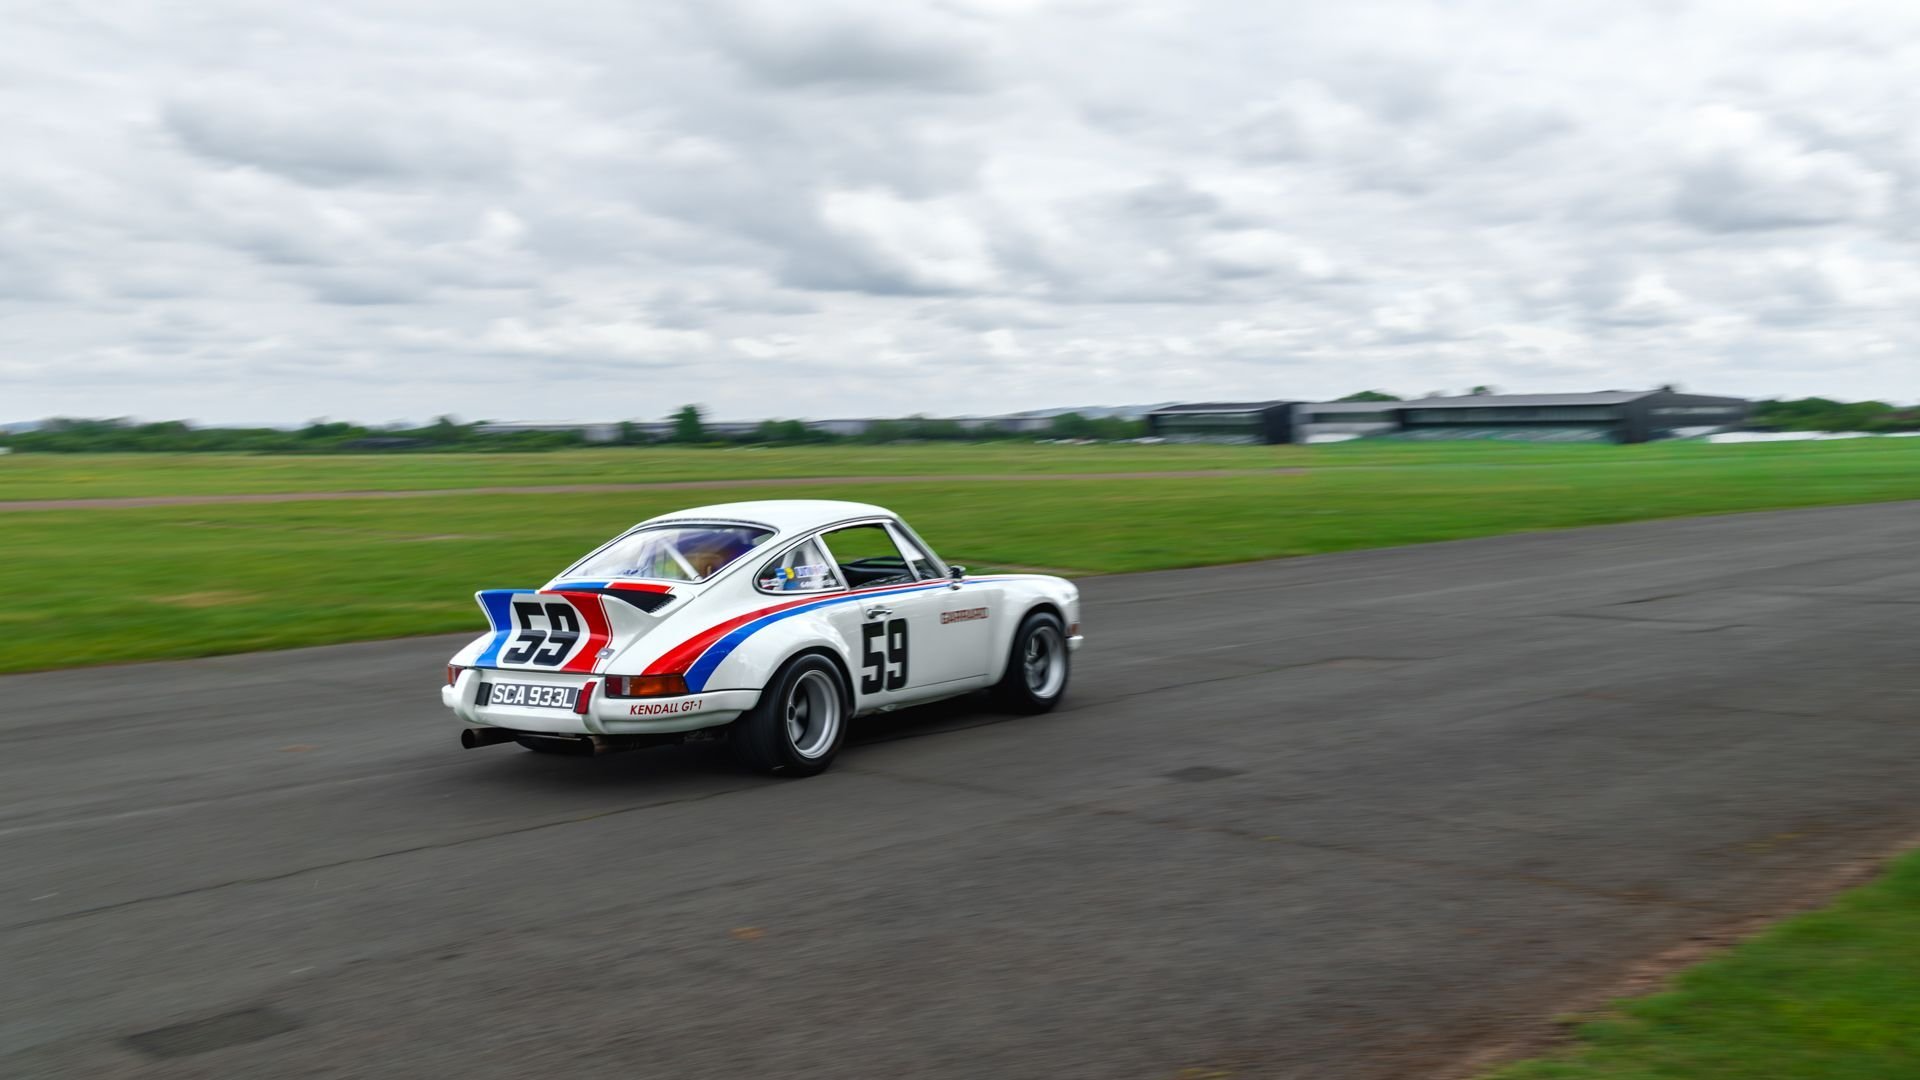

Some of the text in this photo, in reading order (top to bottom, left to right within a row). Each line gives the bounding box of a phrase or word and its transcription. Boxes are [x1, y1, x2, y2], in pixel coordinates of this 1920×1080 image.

[502, 601, 580, 666] 59
[861, 618, 909, 695] 59
[492, 684, 574, 709] SCA 933L
[629, 699, 703, 716] KENDALL GT-1
